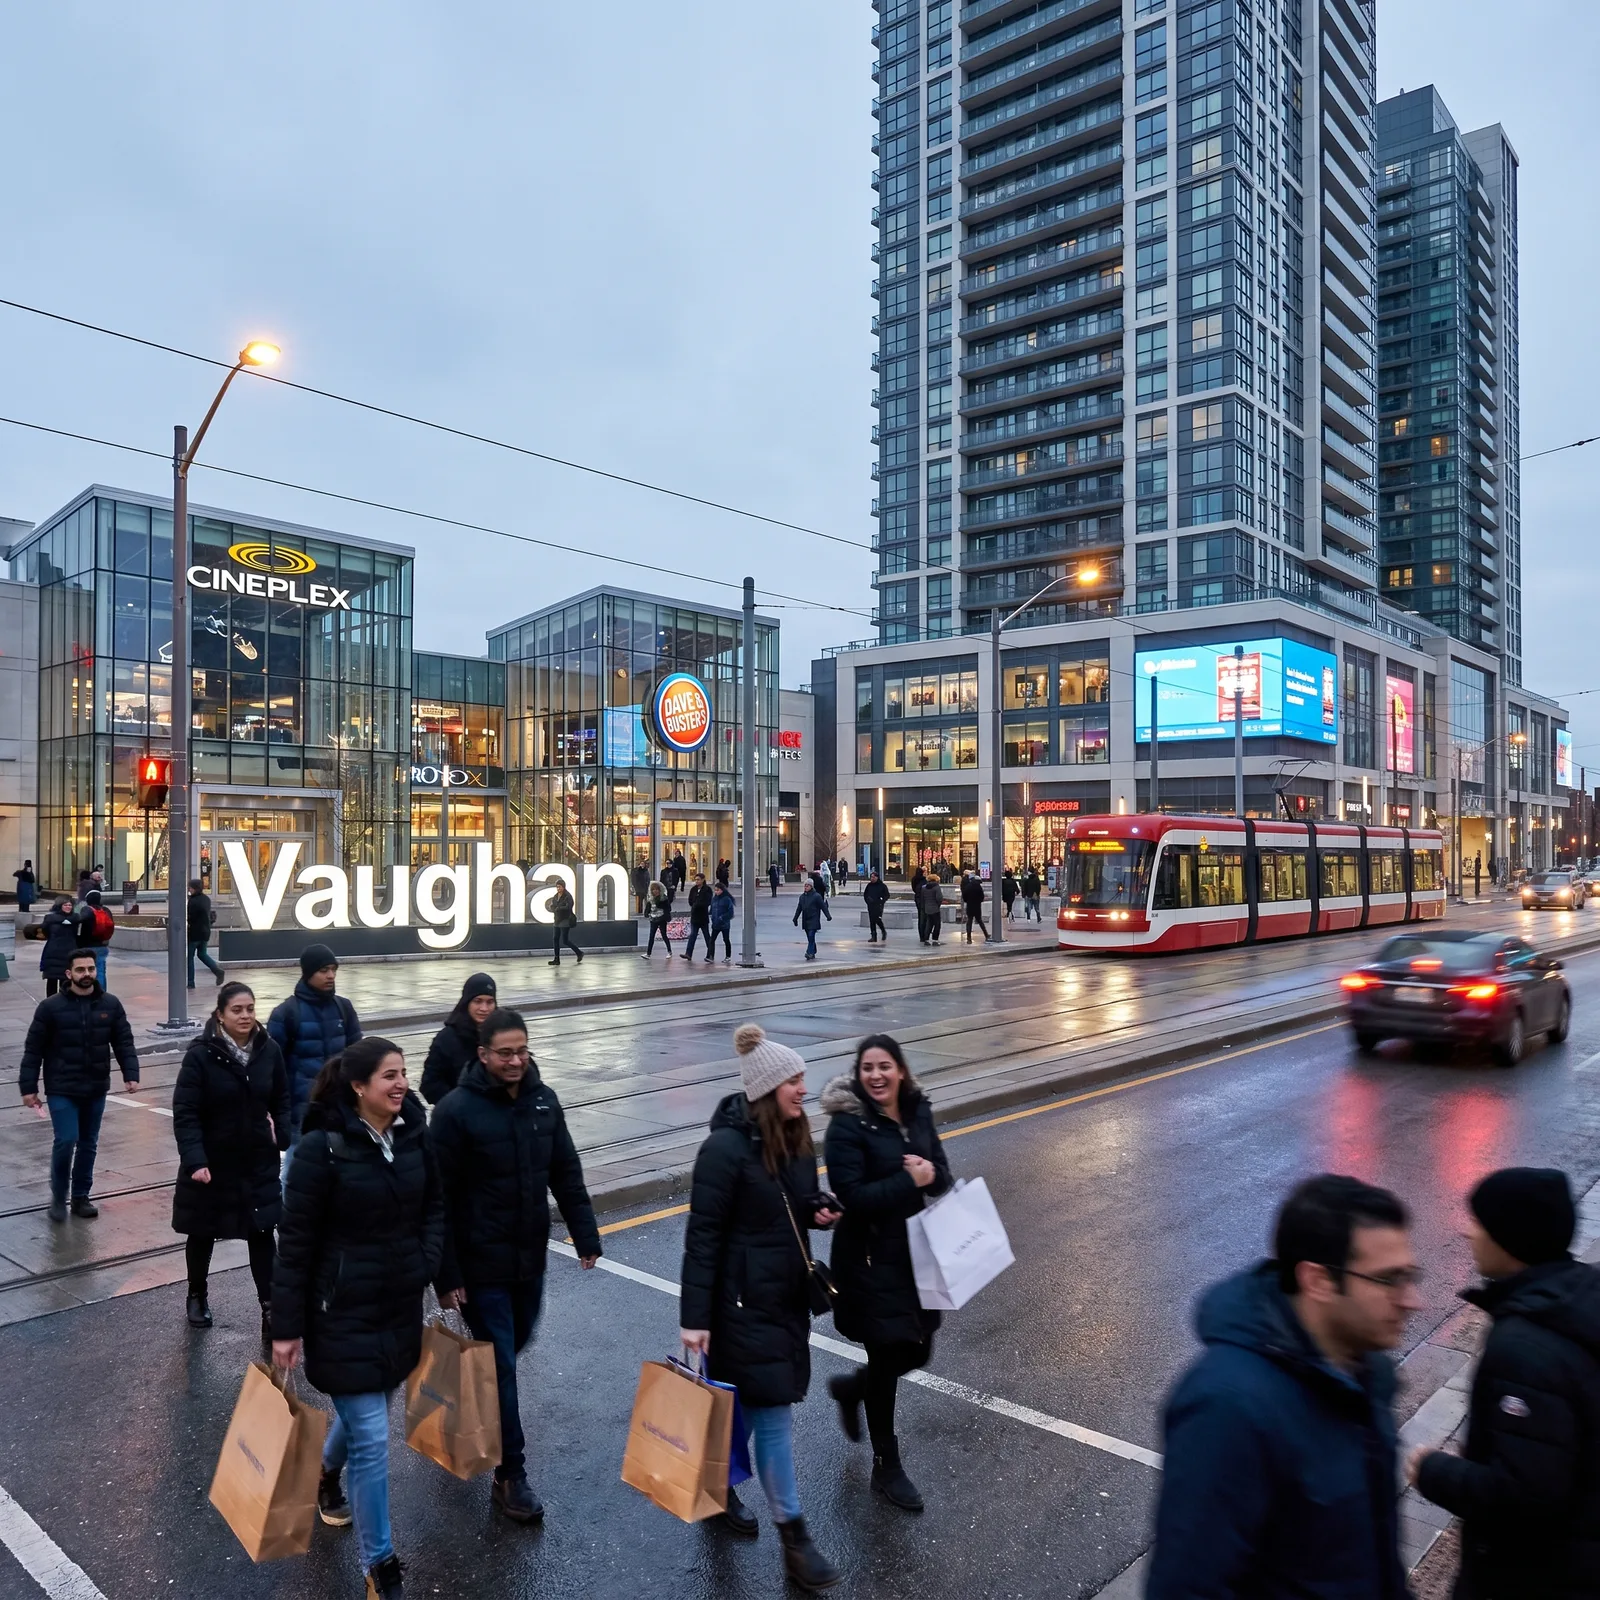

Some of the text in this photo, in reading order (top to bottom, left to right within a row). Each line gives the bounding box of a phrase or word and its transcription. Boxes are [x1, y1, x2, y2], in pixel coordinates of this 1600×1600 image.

[186, 565, 351, 610] CINEPLEX
[664, 691, 705, 717] DAVE &
[222, 841, 630, 949] Vaughan
